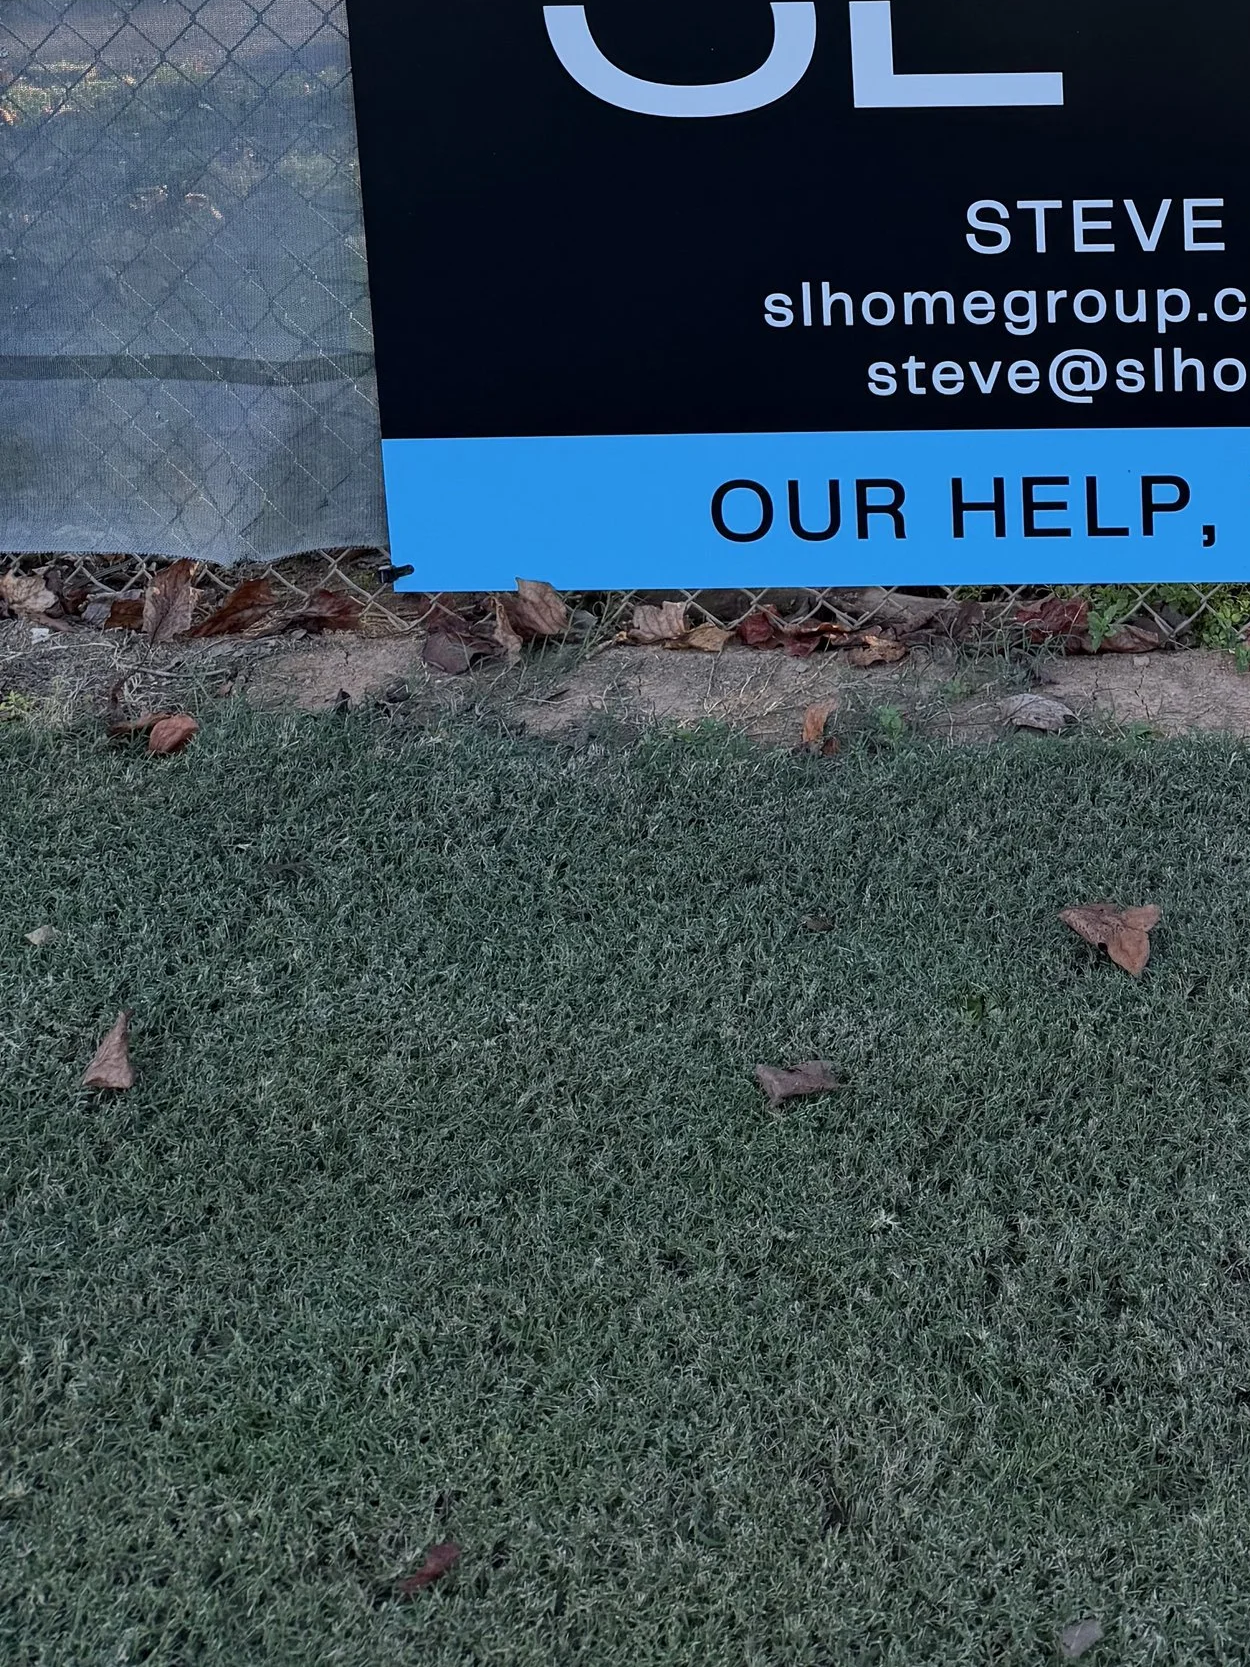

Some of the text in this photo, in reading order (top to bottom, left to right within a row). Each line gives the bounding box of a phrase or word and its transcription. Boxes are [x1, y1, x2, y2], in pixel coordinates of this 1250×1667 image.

[965, 198, 1226, 255] STEVE
[711, 478, 906, 543] OUR
[951, 475, 1216, 548] HELP,
